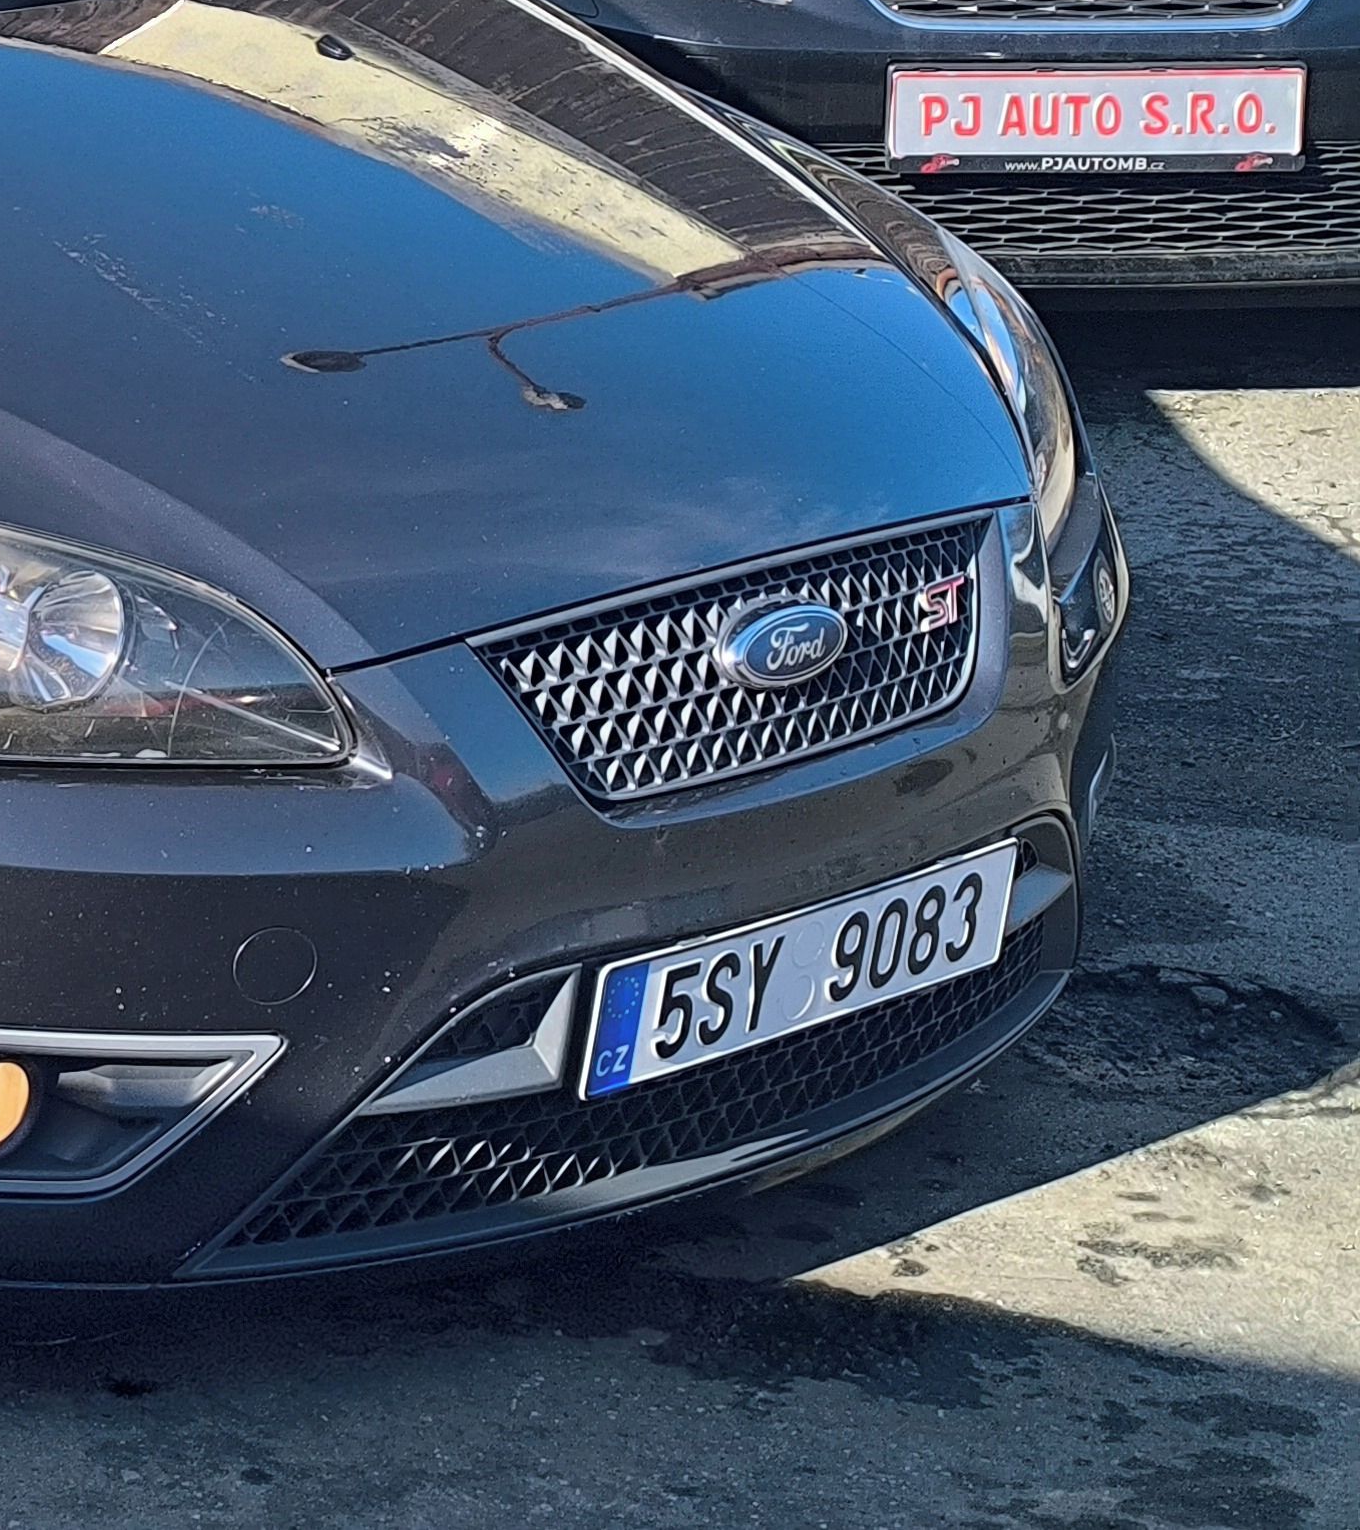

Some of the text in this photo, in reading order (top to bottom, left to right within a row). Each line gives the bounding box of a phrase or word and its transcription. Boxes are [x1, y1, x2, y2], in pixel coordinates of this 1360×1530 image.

[919, 91, 1277, 137] PJ AUTO S.R.O.
[1004, 157, 1166, 172] www.PJAUTOMB.cz
[921, 572, 965, 633] ST
[766, 622, 826, 671] Ford
[653, 872, 984, 1060] 5SY 9083
[595, 1044, 629, 1079] CZ
